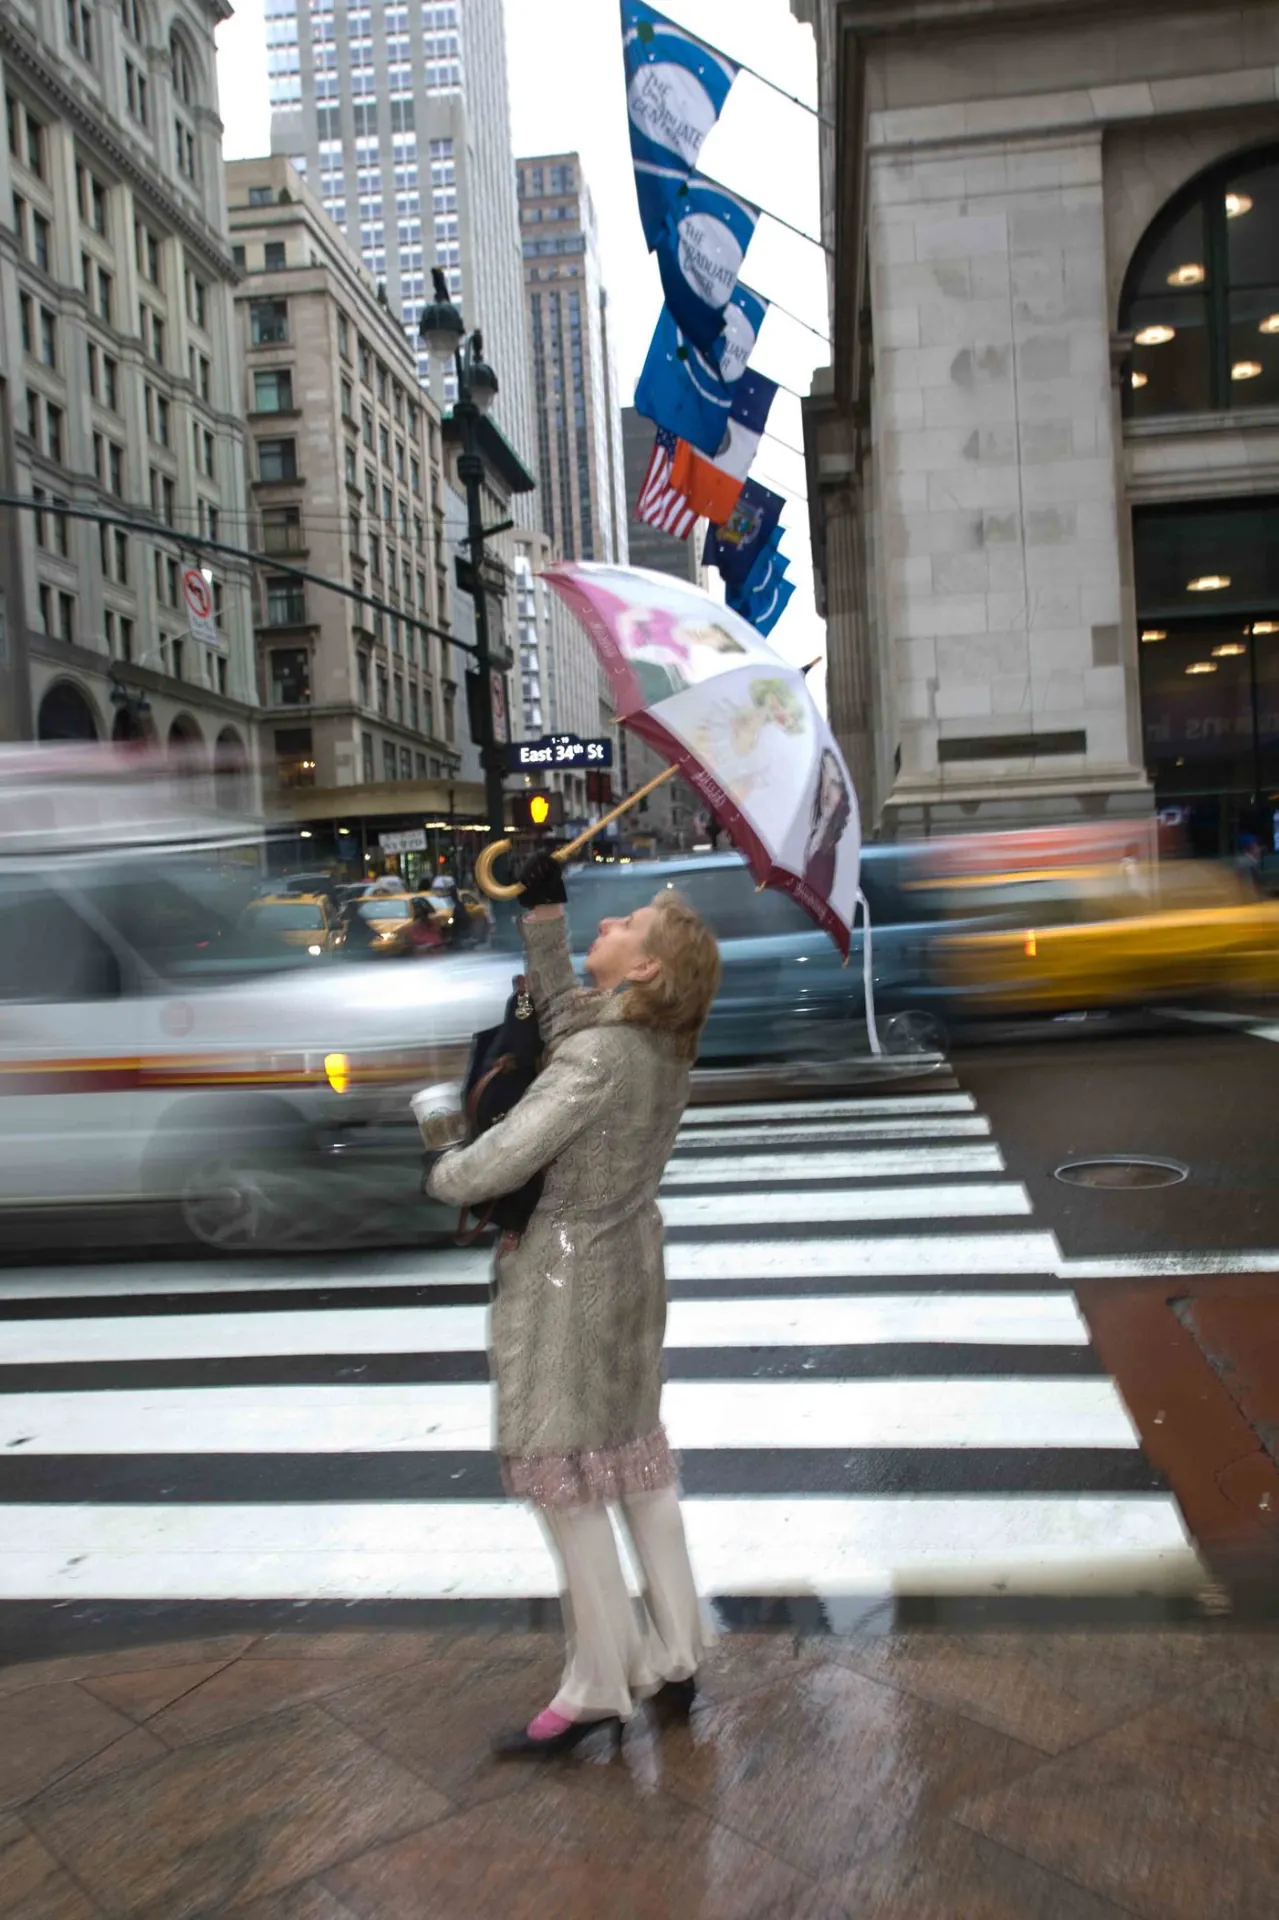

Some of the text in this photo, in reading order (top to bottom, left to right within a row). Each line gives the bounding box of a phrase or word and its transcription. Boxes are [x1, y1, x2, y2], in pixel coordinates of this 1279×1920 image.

[685, 221, 704, 245] THE
[682, 239, 737, 286] RADUATE
[520, 743, 605, 763] East 34th St
